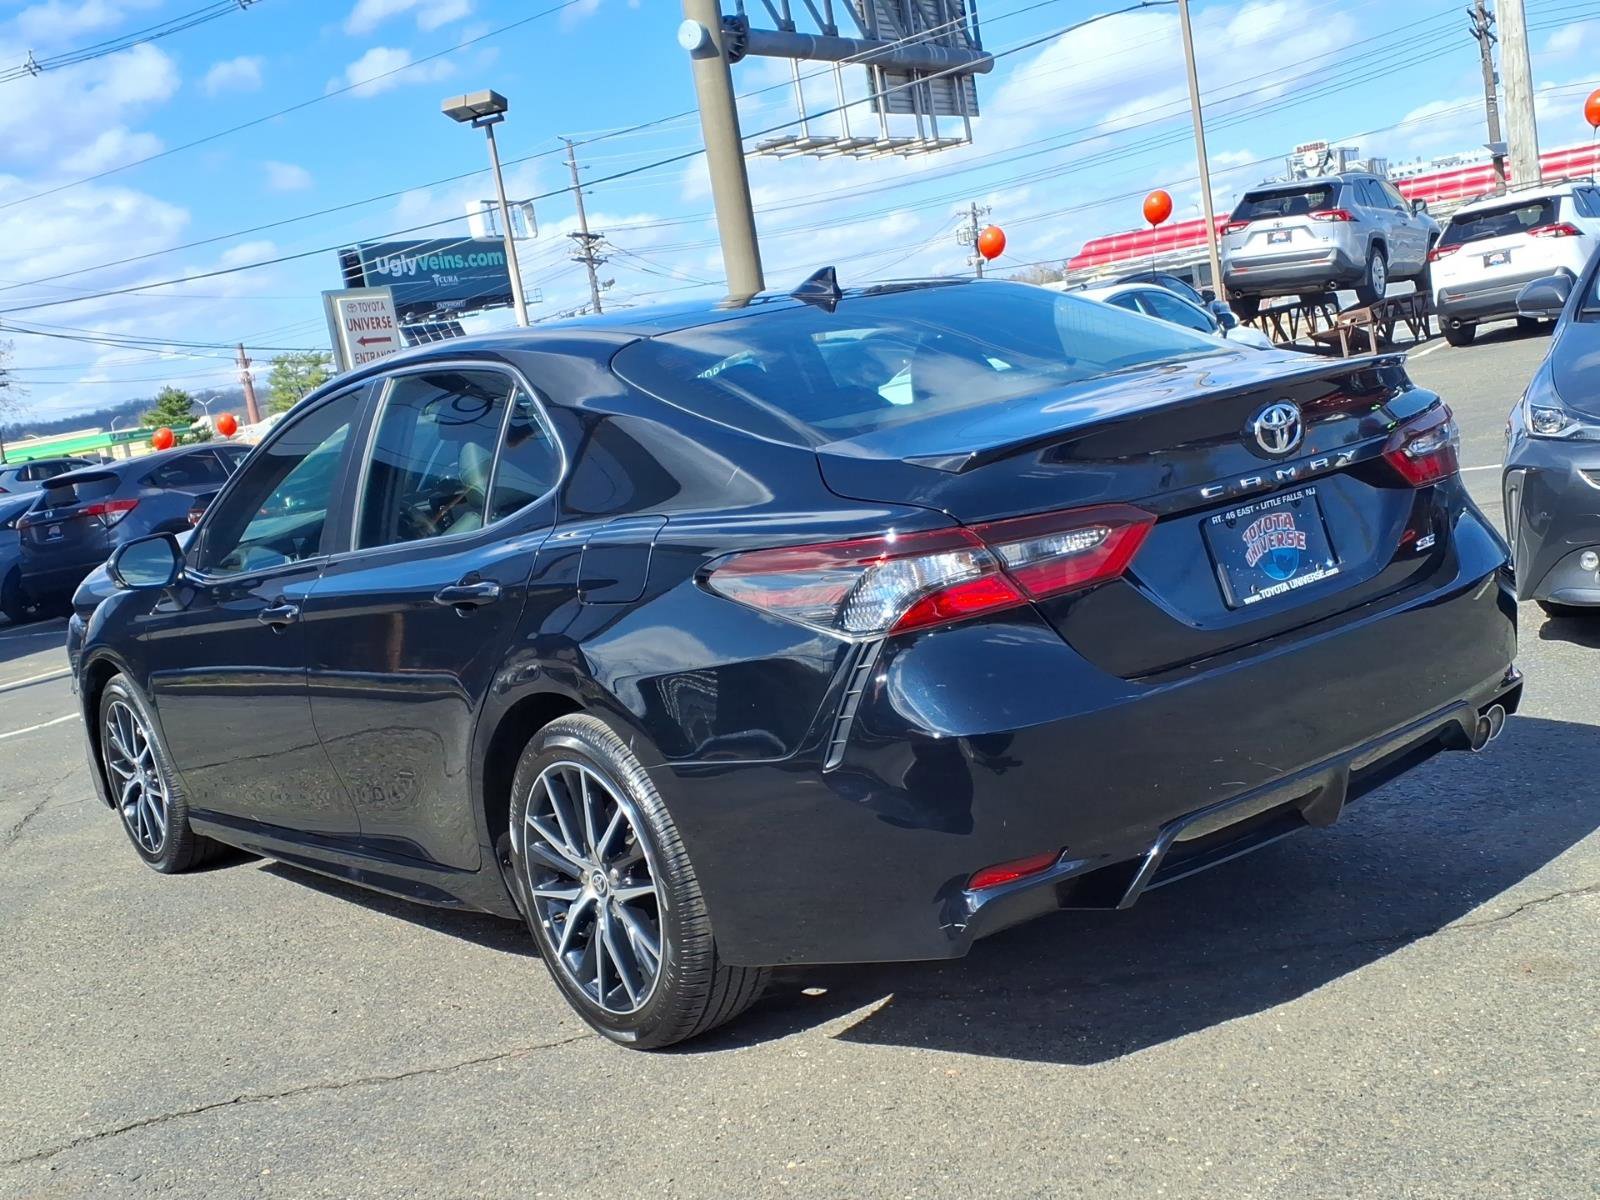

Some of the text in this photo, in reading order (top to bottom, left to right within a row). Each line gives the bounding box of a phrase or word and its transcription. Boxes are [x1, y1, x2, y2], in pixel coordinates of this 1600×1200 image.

[375, 251, 504, 277] UglyVeins.com
[358, 301, 385, 312] TOYOTA
[346, 316, 392, 331] UNIVERSE
[1201, 450, 1356, 499] CAMRY
[1212, 487, 1316, 525] RT. 46 EAST LITTLE FALLS, NJ
[1242, 512, 1296, 547] TOYOTA
[1416, 533, 1436, 551] SE
[1245, 530, 1307, 568] UNIVERSE
